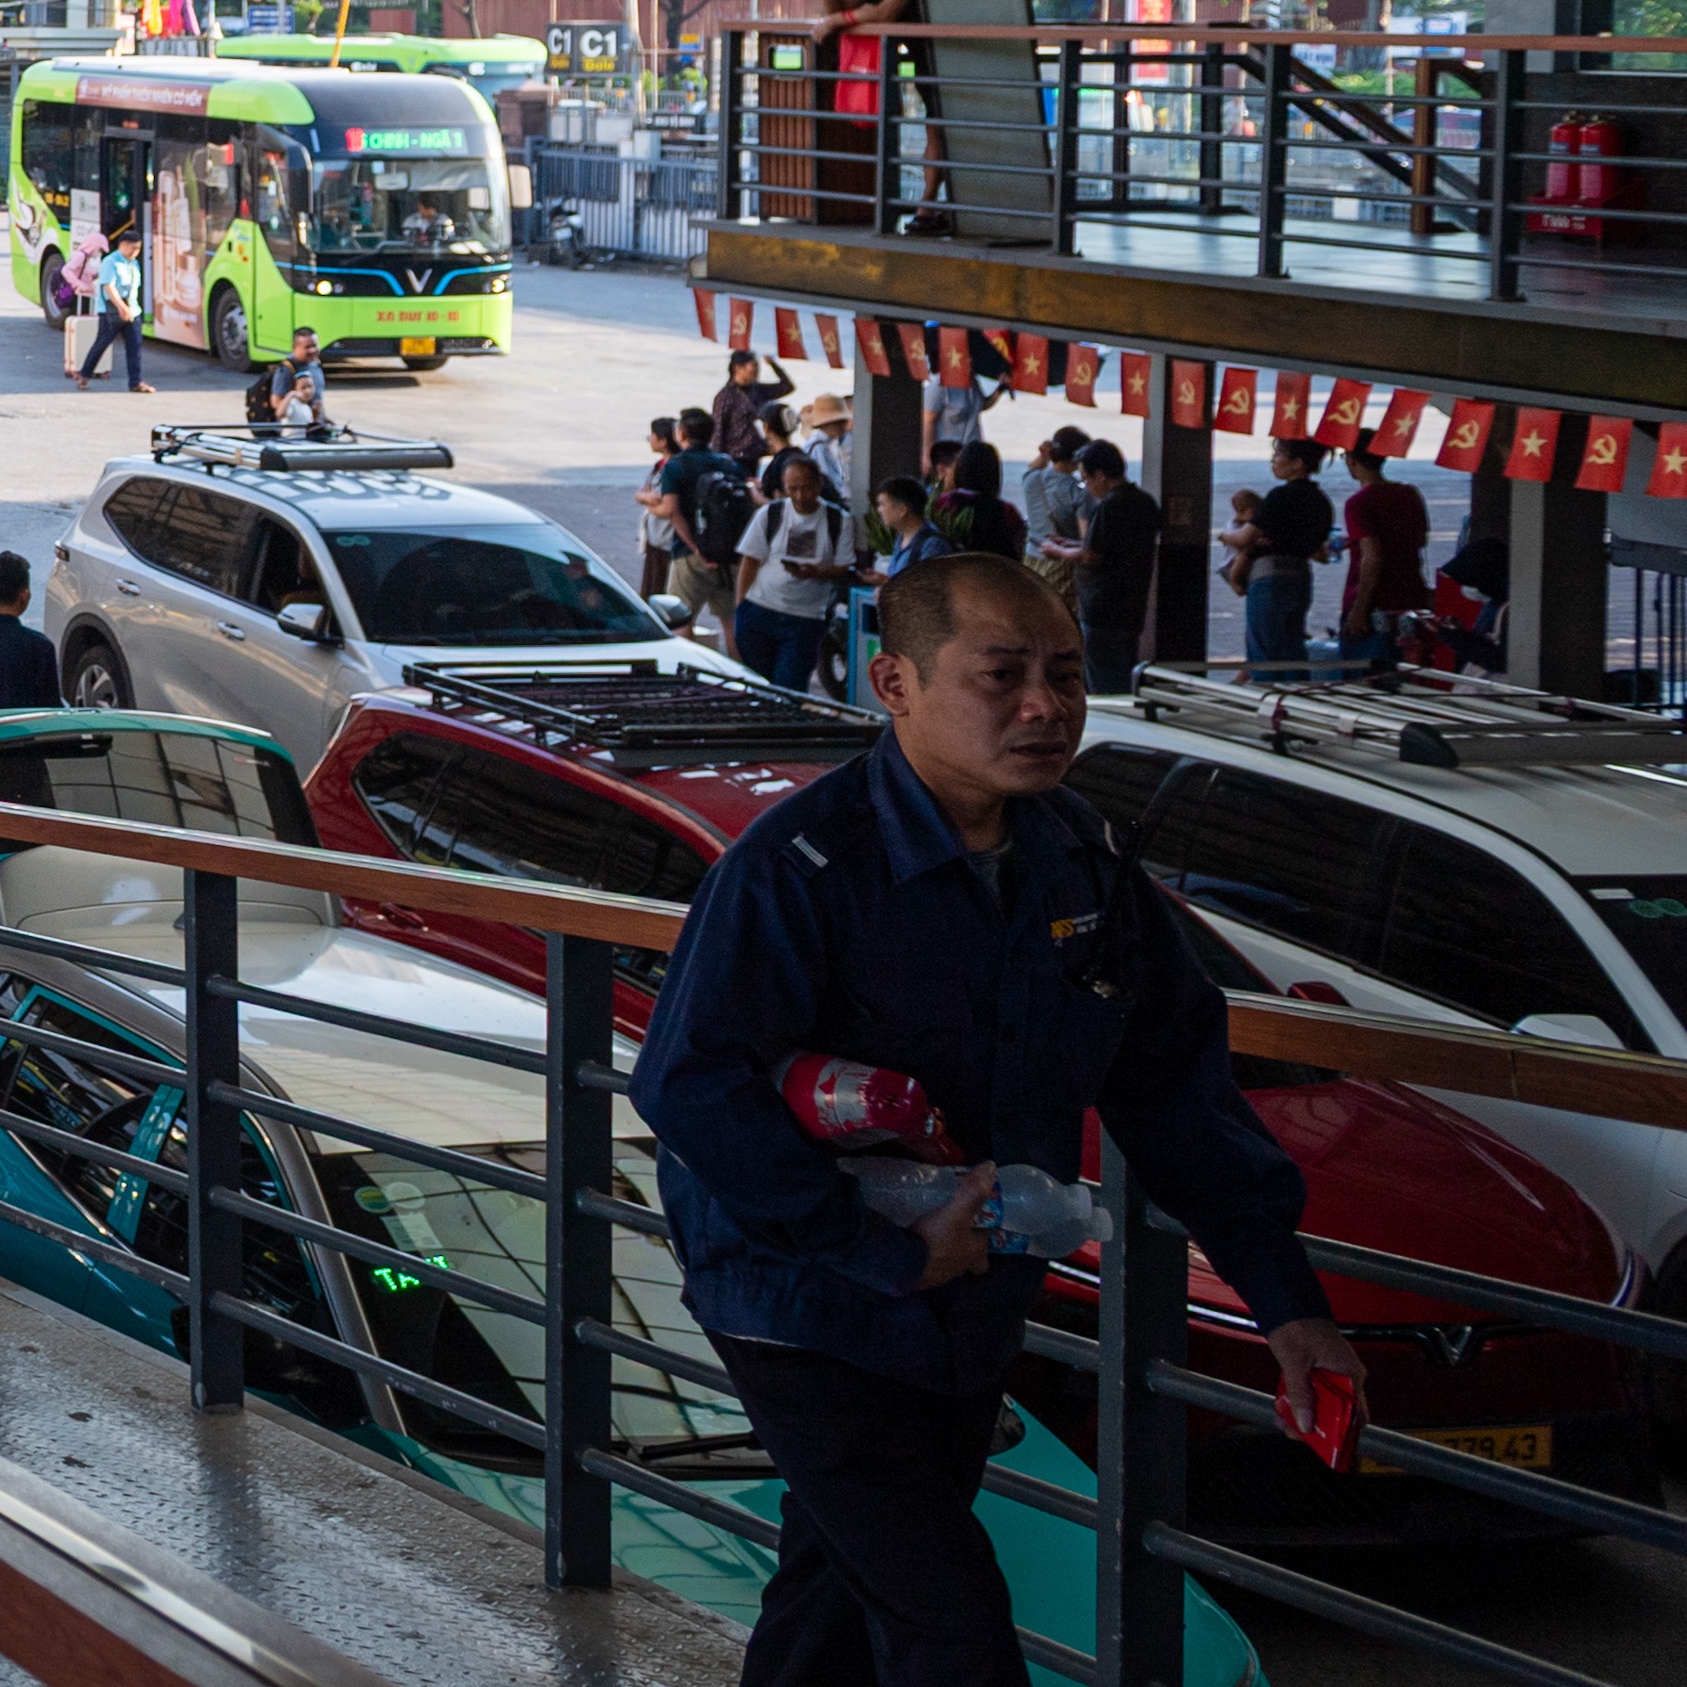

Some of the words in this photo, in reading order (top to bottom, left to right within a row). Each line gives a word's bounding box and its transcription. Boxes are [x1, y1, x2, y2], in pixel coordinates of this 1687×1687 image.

[548, 27, 572, 55] C1
[580, 29, 617, 57] C1
[374, 1255, 449, 1291] TAI
